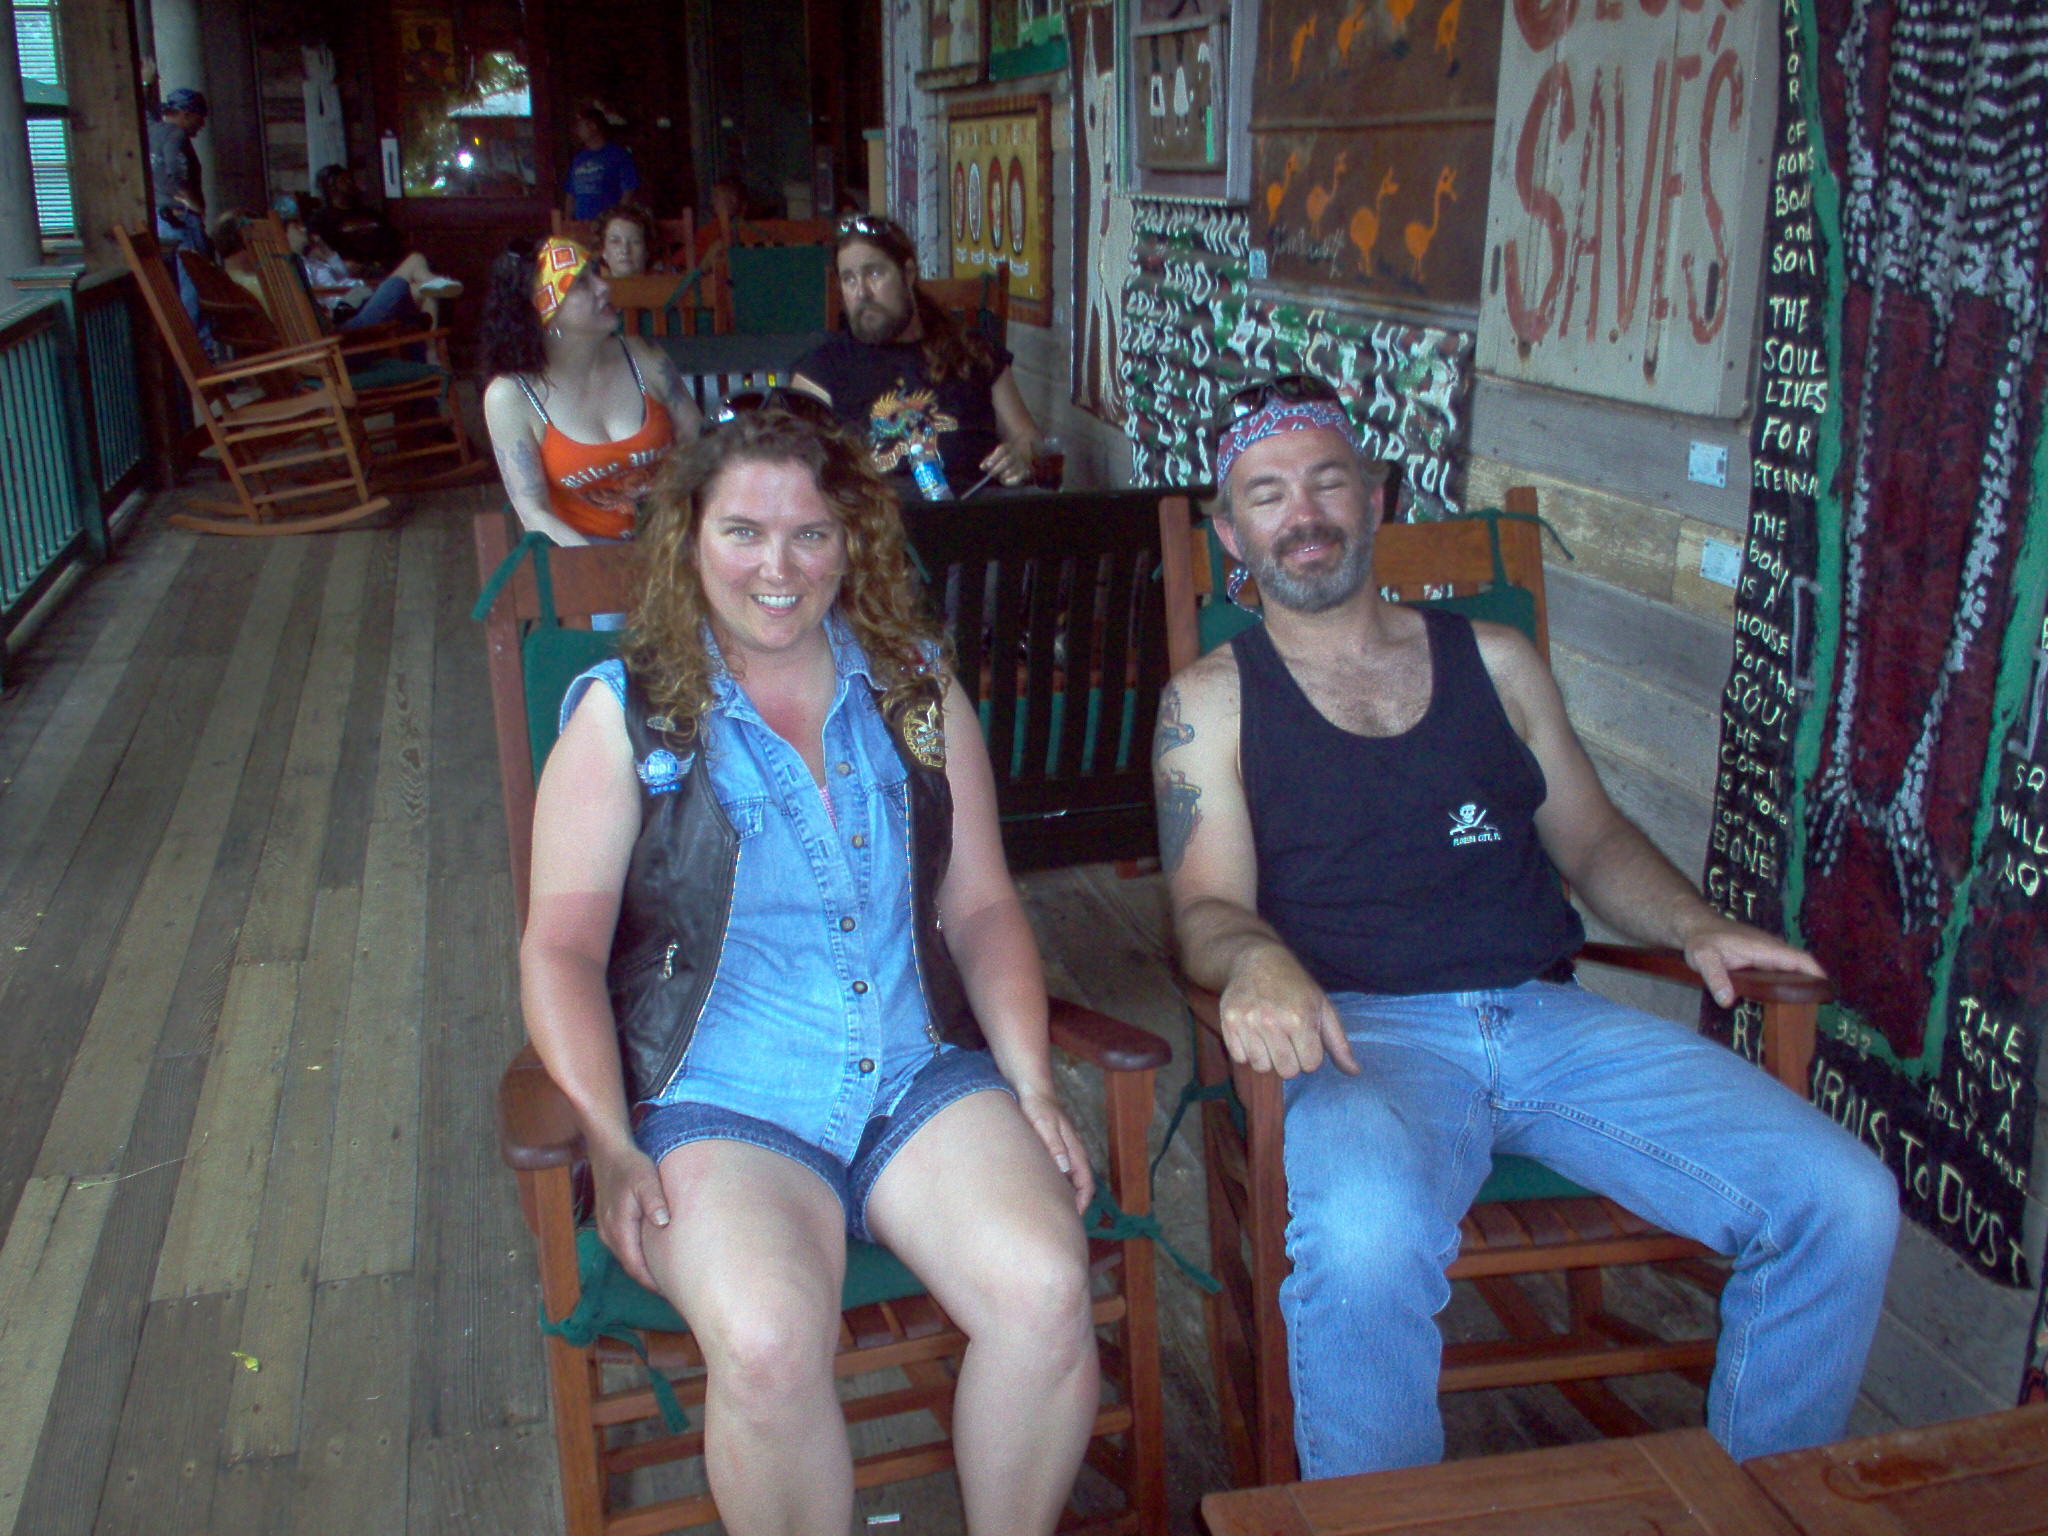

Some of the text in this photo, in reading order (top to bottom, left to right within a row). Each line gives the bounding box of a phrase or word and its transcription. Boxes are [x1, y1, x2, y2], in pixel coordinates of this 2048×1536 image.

[1503, 48, 1745, 346] SAVES
[1768, 297, 1809, 333] THE
[1763, 337, 1825, 376] SOUL
[1765, 380, 1828, 413] LIVES
[1761, 415, 1812, 458] FOR
[1753, 511, 1787, 541] THE
[1741, 575, 1776, 613] IS A
[1735, 608, 1789, 656] HOUSE
[1726, 673, 1788, 742] SOUL
[1722, 711, 1761, 753] THE
[1708, 866, 1758, 920] GET
[1959, 997, 2025, 1063] THE
[1960, 1028, 2022, 1111] BODY
[1926, 1084, 1975, 1142] HOLY
[1996, 1110, 2012, 1147] A
